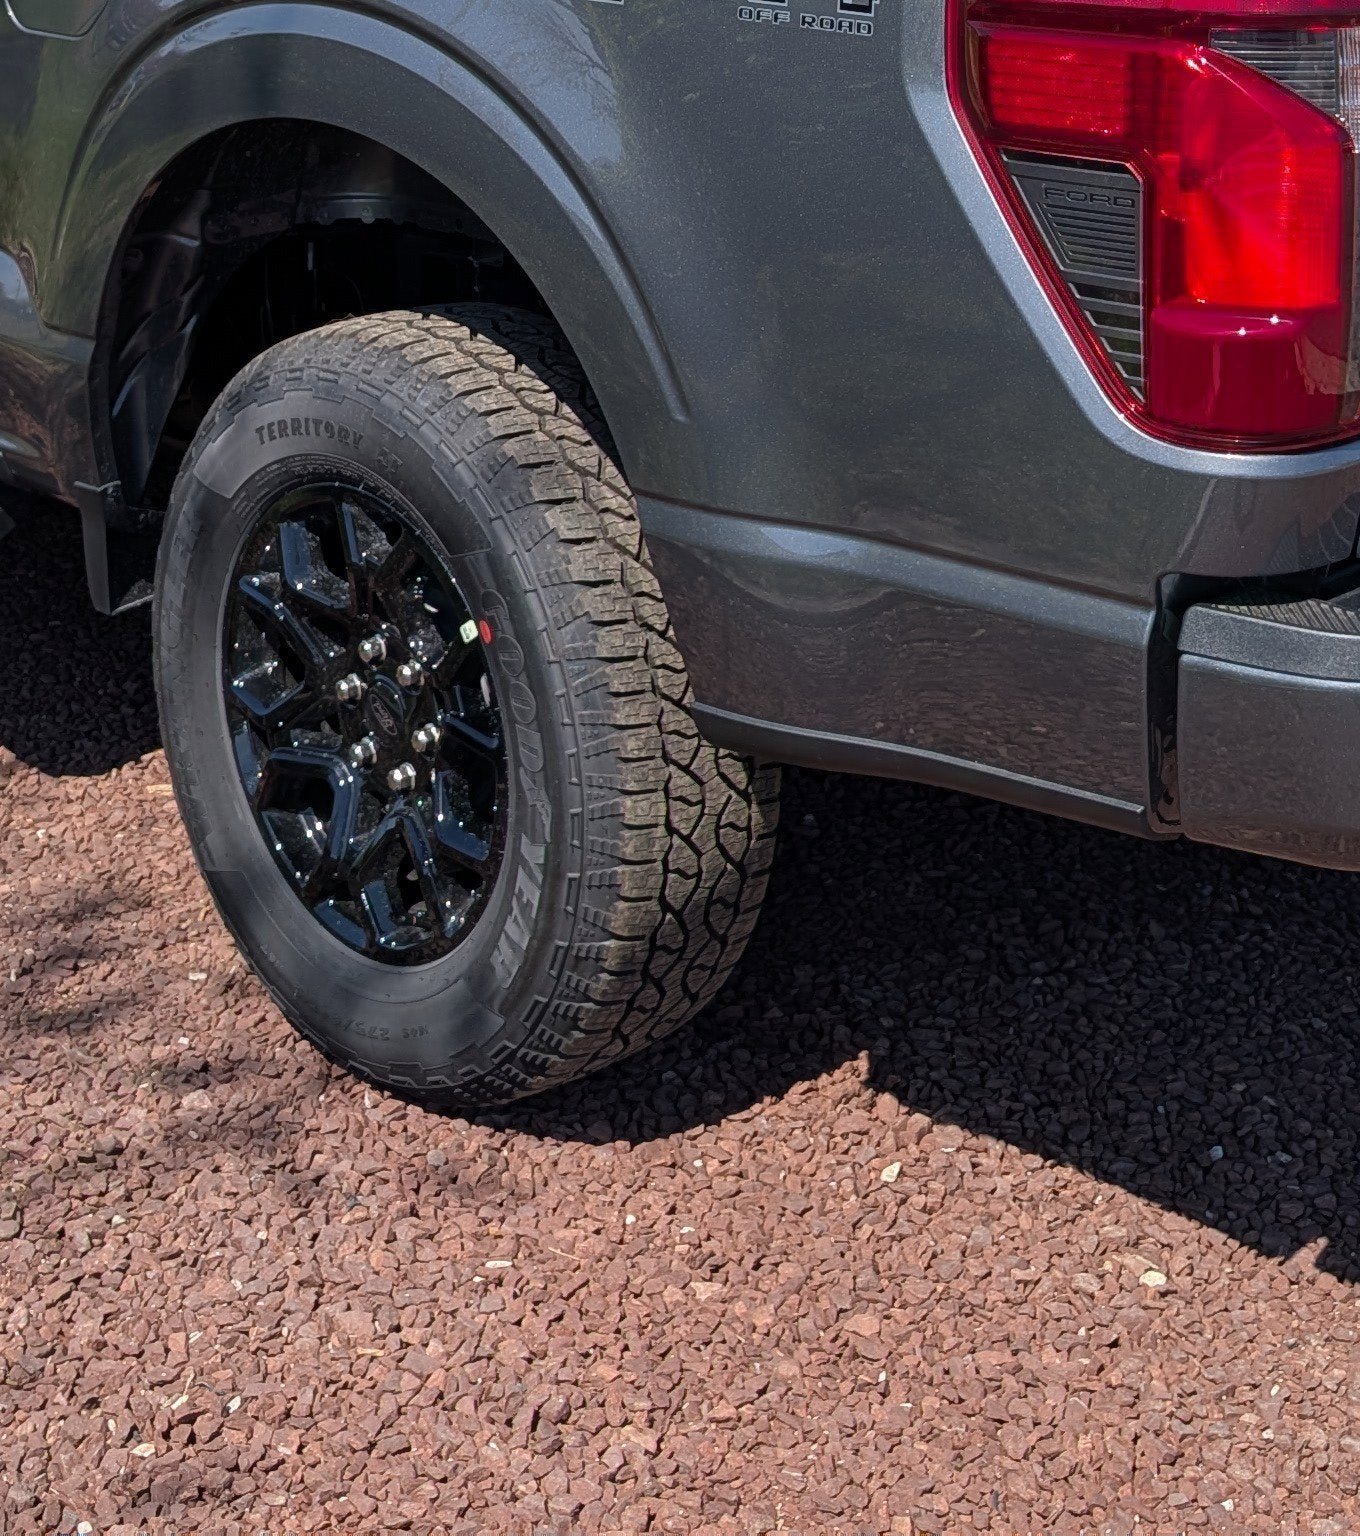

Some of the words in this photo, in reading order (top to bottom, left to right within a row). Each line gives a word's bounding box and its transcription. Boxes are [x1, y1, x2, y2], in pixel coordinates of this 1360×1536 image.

[738, 5, 790, 26] OFF
[801, 12, 873, 36] ROAD
[1043, 186, 1136, 209] FORD
[254, 417, 364, 450] TERRITORY
